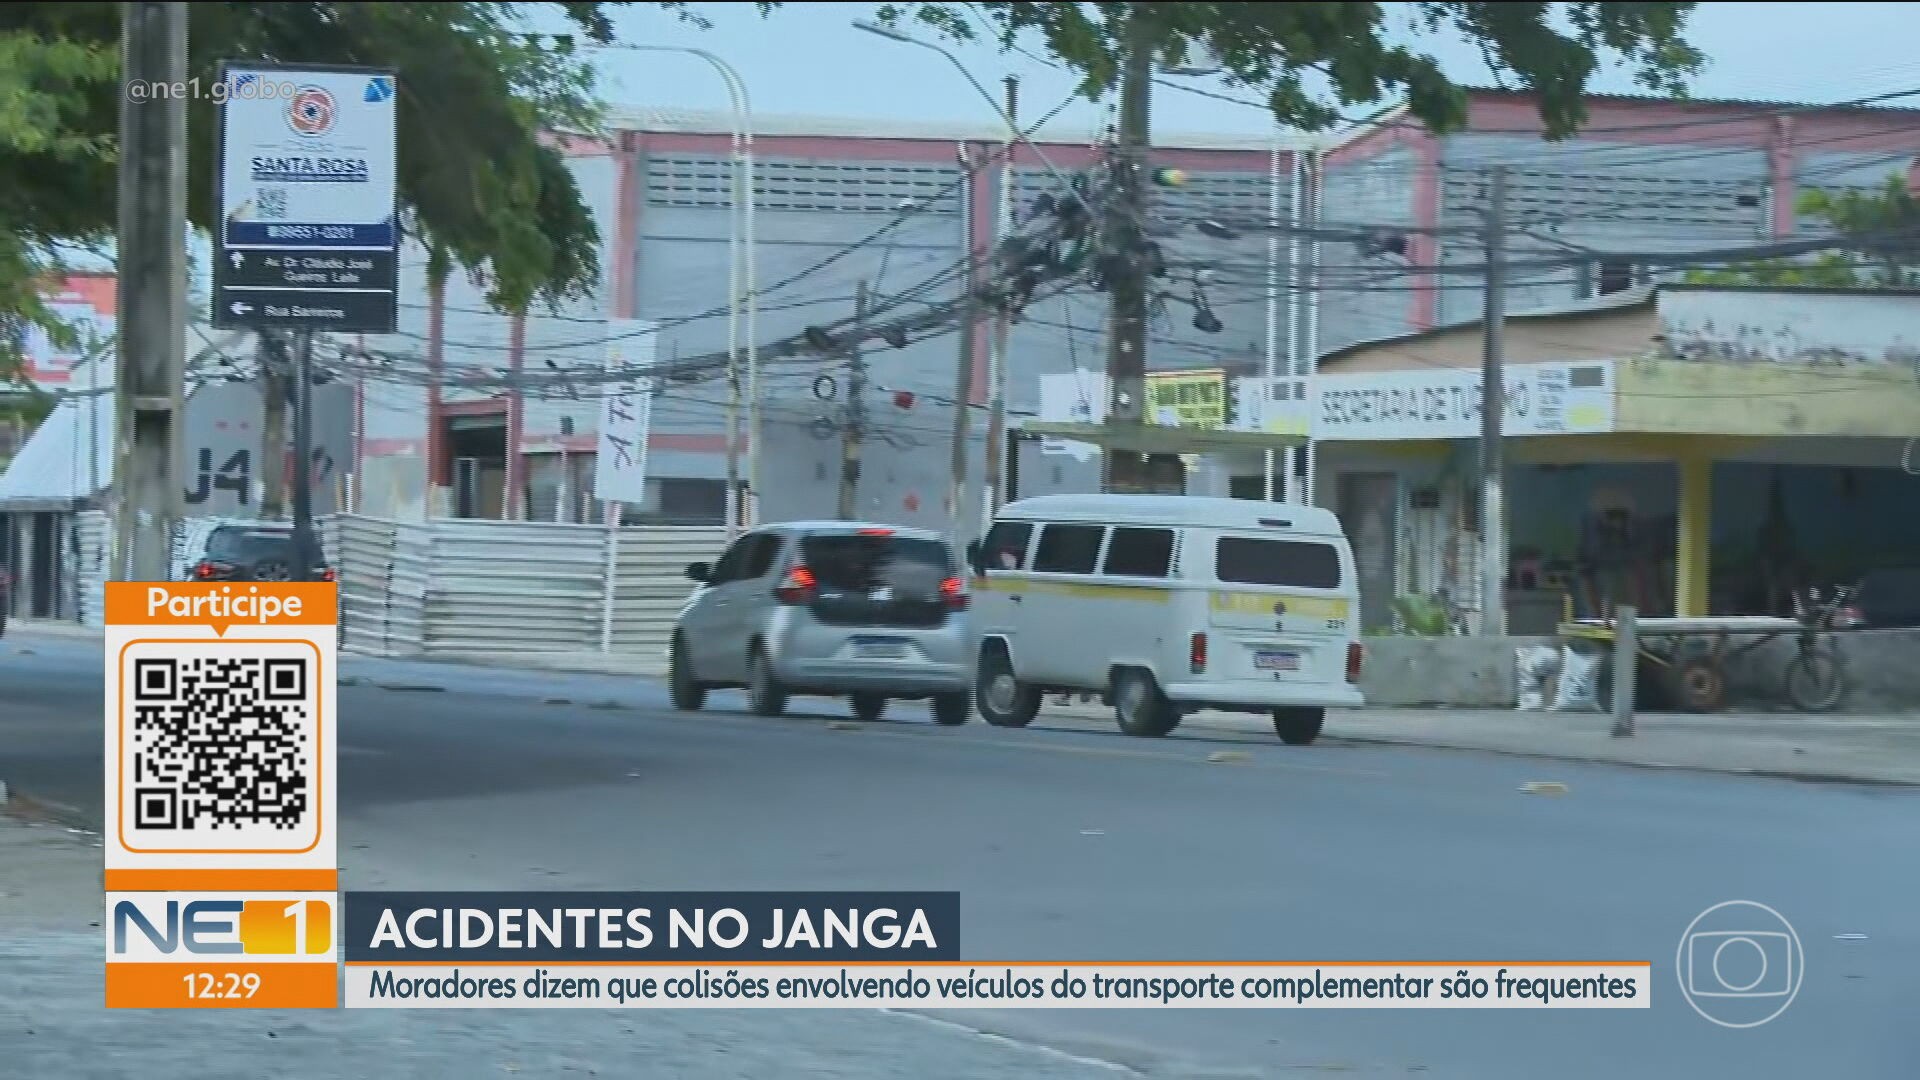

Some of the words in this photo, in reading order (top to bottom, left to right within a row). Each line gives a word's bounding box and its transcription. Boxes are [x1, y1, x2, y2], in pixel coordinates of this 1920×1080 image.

[251, 157, 315, 172] SANTA
[318, 159, 368, 173] ROSA
[265, 306, 289, 317] Rua
[1322, 388, 1418, 424] SECRETARIA
[1424, 387, 1447, 421] DE
[1450, 379, 1530, 421] TURMO
